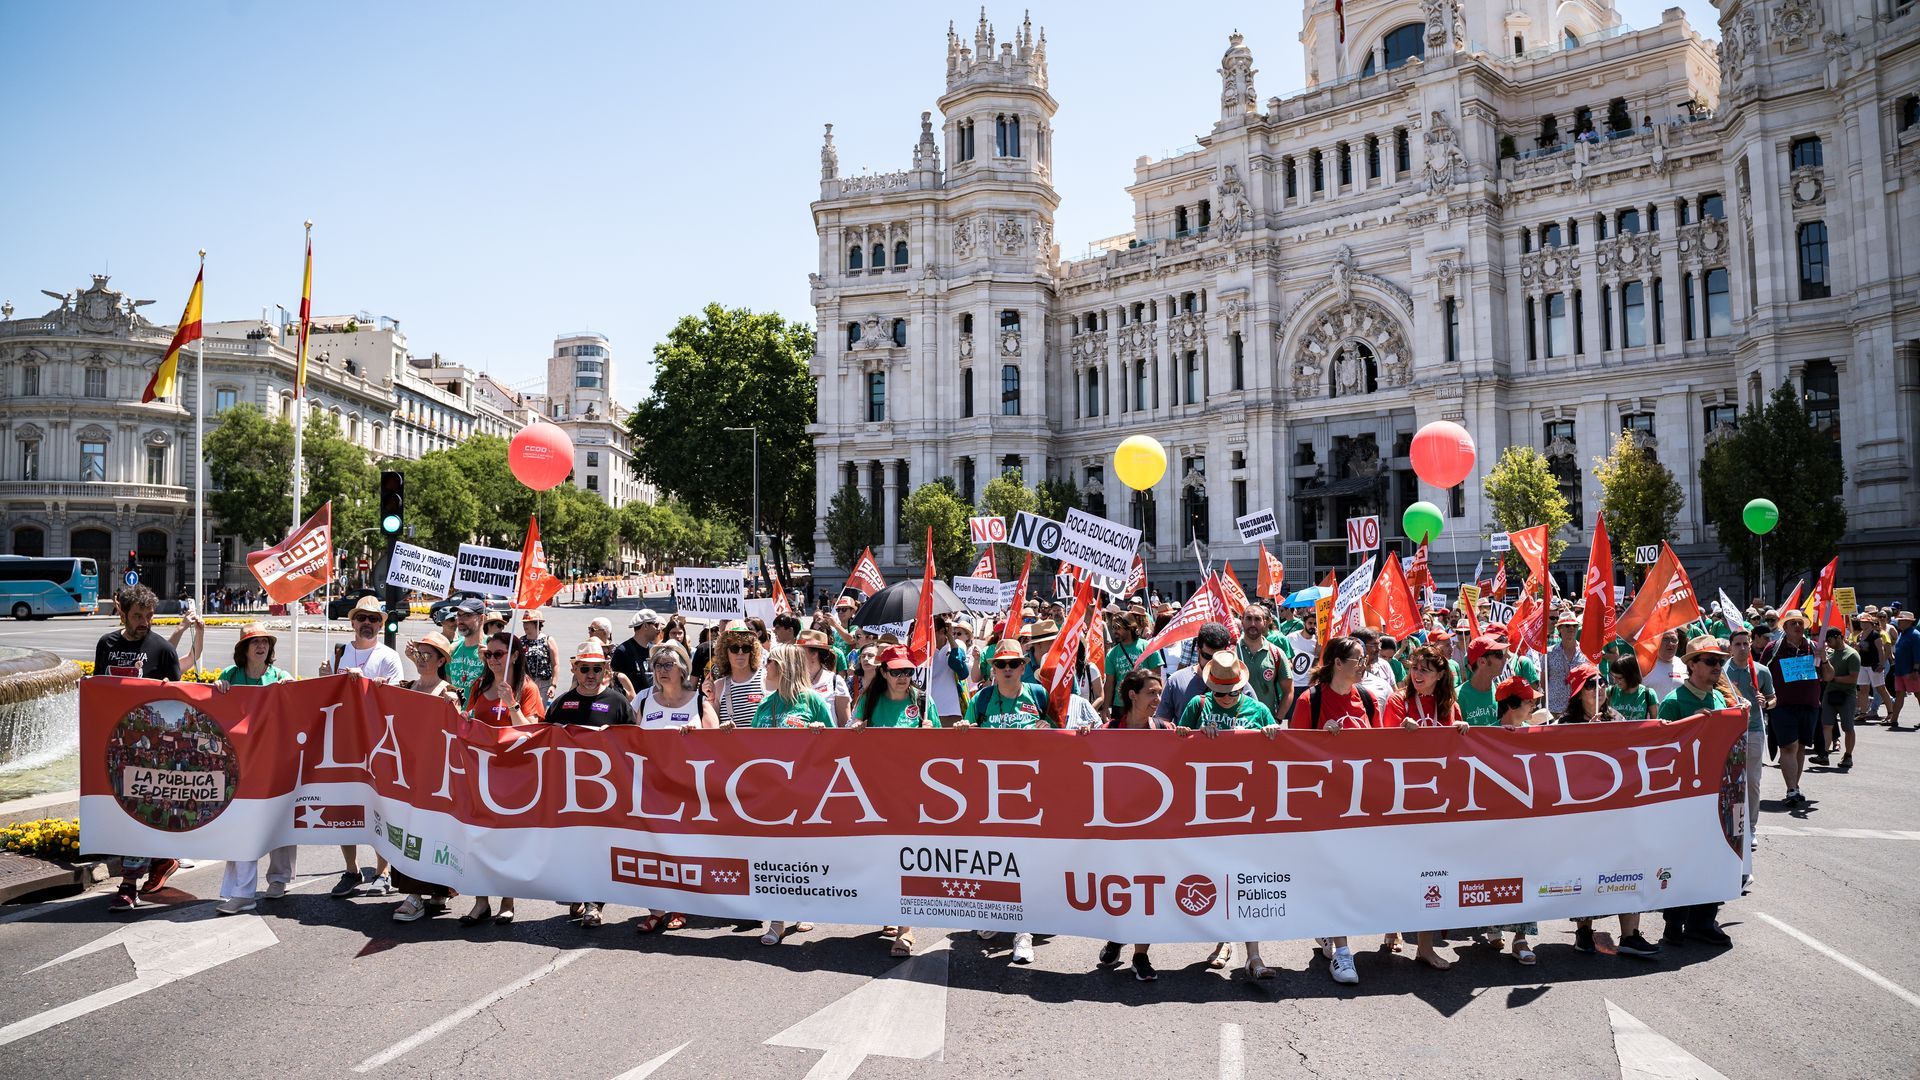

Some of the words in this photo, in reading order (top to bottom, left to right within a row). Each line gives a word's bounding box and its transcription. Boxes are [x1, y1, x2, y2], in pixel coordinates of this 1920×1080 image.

[1240, 513, 1274, 530] DICTADURA
[1010, 513, 1063, 554] NO
[1066, 514, 1088, 533] POCA
[1087, 525, 1136, 554] EDUCACIÓN,
[394, 545, 420, 560] Escuela
[427, 555, 453, 569] medios:
[459, 553, 519, 573] DICTADURA
[1060, 537, 1081, 554] POCA
[1078, 544, 1127, 575] DEMOCRACIA.
[400, 560, 442, 579] PRIVATIZAN
[390, 571, 410, 583] PARA
[410, 575, 445, 594] ENGAÑAR
[684, 578, 695, 593] PP:
[697, 579, 740, 594] DES-EDUCAR
[955, 582, 971, 592] Piden
[972, 584, 999, 595] libertad...
[677, 596, 698, 611] PARA
[700, 597, 741, 613] DOMINAR.
[967, 596, 998, 607] discriminar!
[295, 702, 410, 799] ¡LA
[918, 757, 1044, 827] SE
[1083, 738, 1702, 828] DEFIENDE!
[134, 770, 152, 784] LA
[158, 770, 214, 787] PÚBLICA
[131, 784, 148, 796] SE
[152, 786, 218, 800] DEFIENDE
[327, 820, 365, 829] apeoim
[753, 860, 816, 873] educación
[822, 862, 830, 875] y
[900, 846, 1020, 877] CONFAPA
[617, 855, 702, 886] CCOO
[754, 872, 810, 884] servicios
[1237, 872, 1291, 885] Servicios
[1598, 872, 1643, 884] Podemos
[755, 883, 858, 898] socioeducativos
[1064, 871, 1166, 917] UGT
[1237, 888, 1287, 901] Públicos
[1597, 886, 1604, 894] C.
[1607, 883, 1636, 893] Madrid
[900, 898, 943, 907] CONFEDERACIÓN
[944, 900, 977, 909] AUTONÓMICA
[977, 902, 984, 910] DE
[984, 903, 1001, 911] AMPAS
[1006, 904, 1024, 912] FAPAS
[1462, 891, 1491, 904] PSOE
[901, 906, 911, 915] DE
[914, 907, 925, 916] LA
[926, 908, 976, 918] COMUNIDAD
[978, 911, 989, 919] DE
[990, 912, 1023, 921] MADRID
[1238, 903, 1286, 919] Madrid
